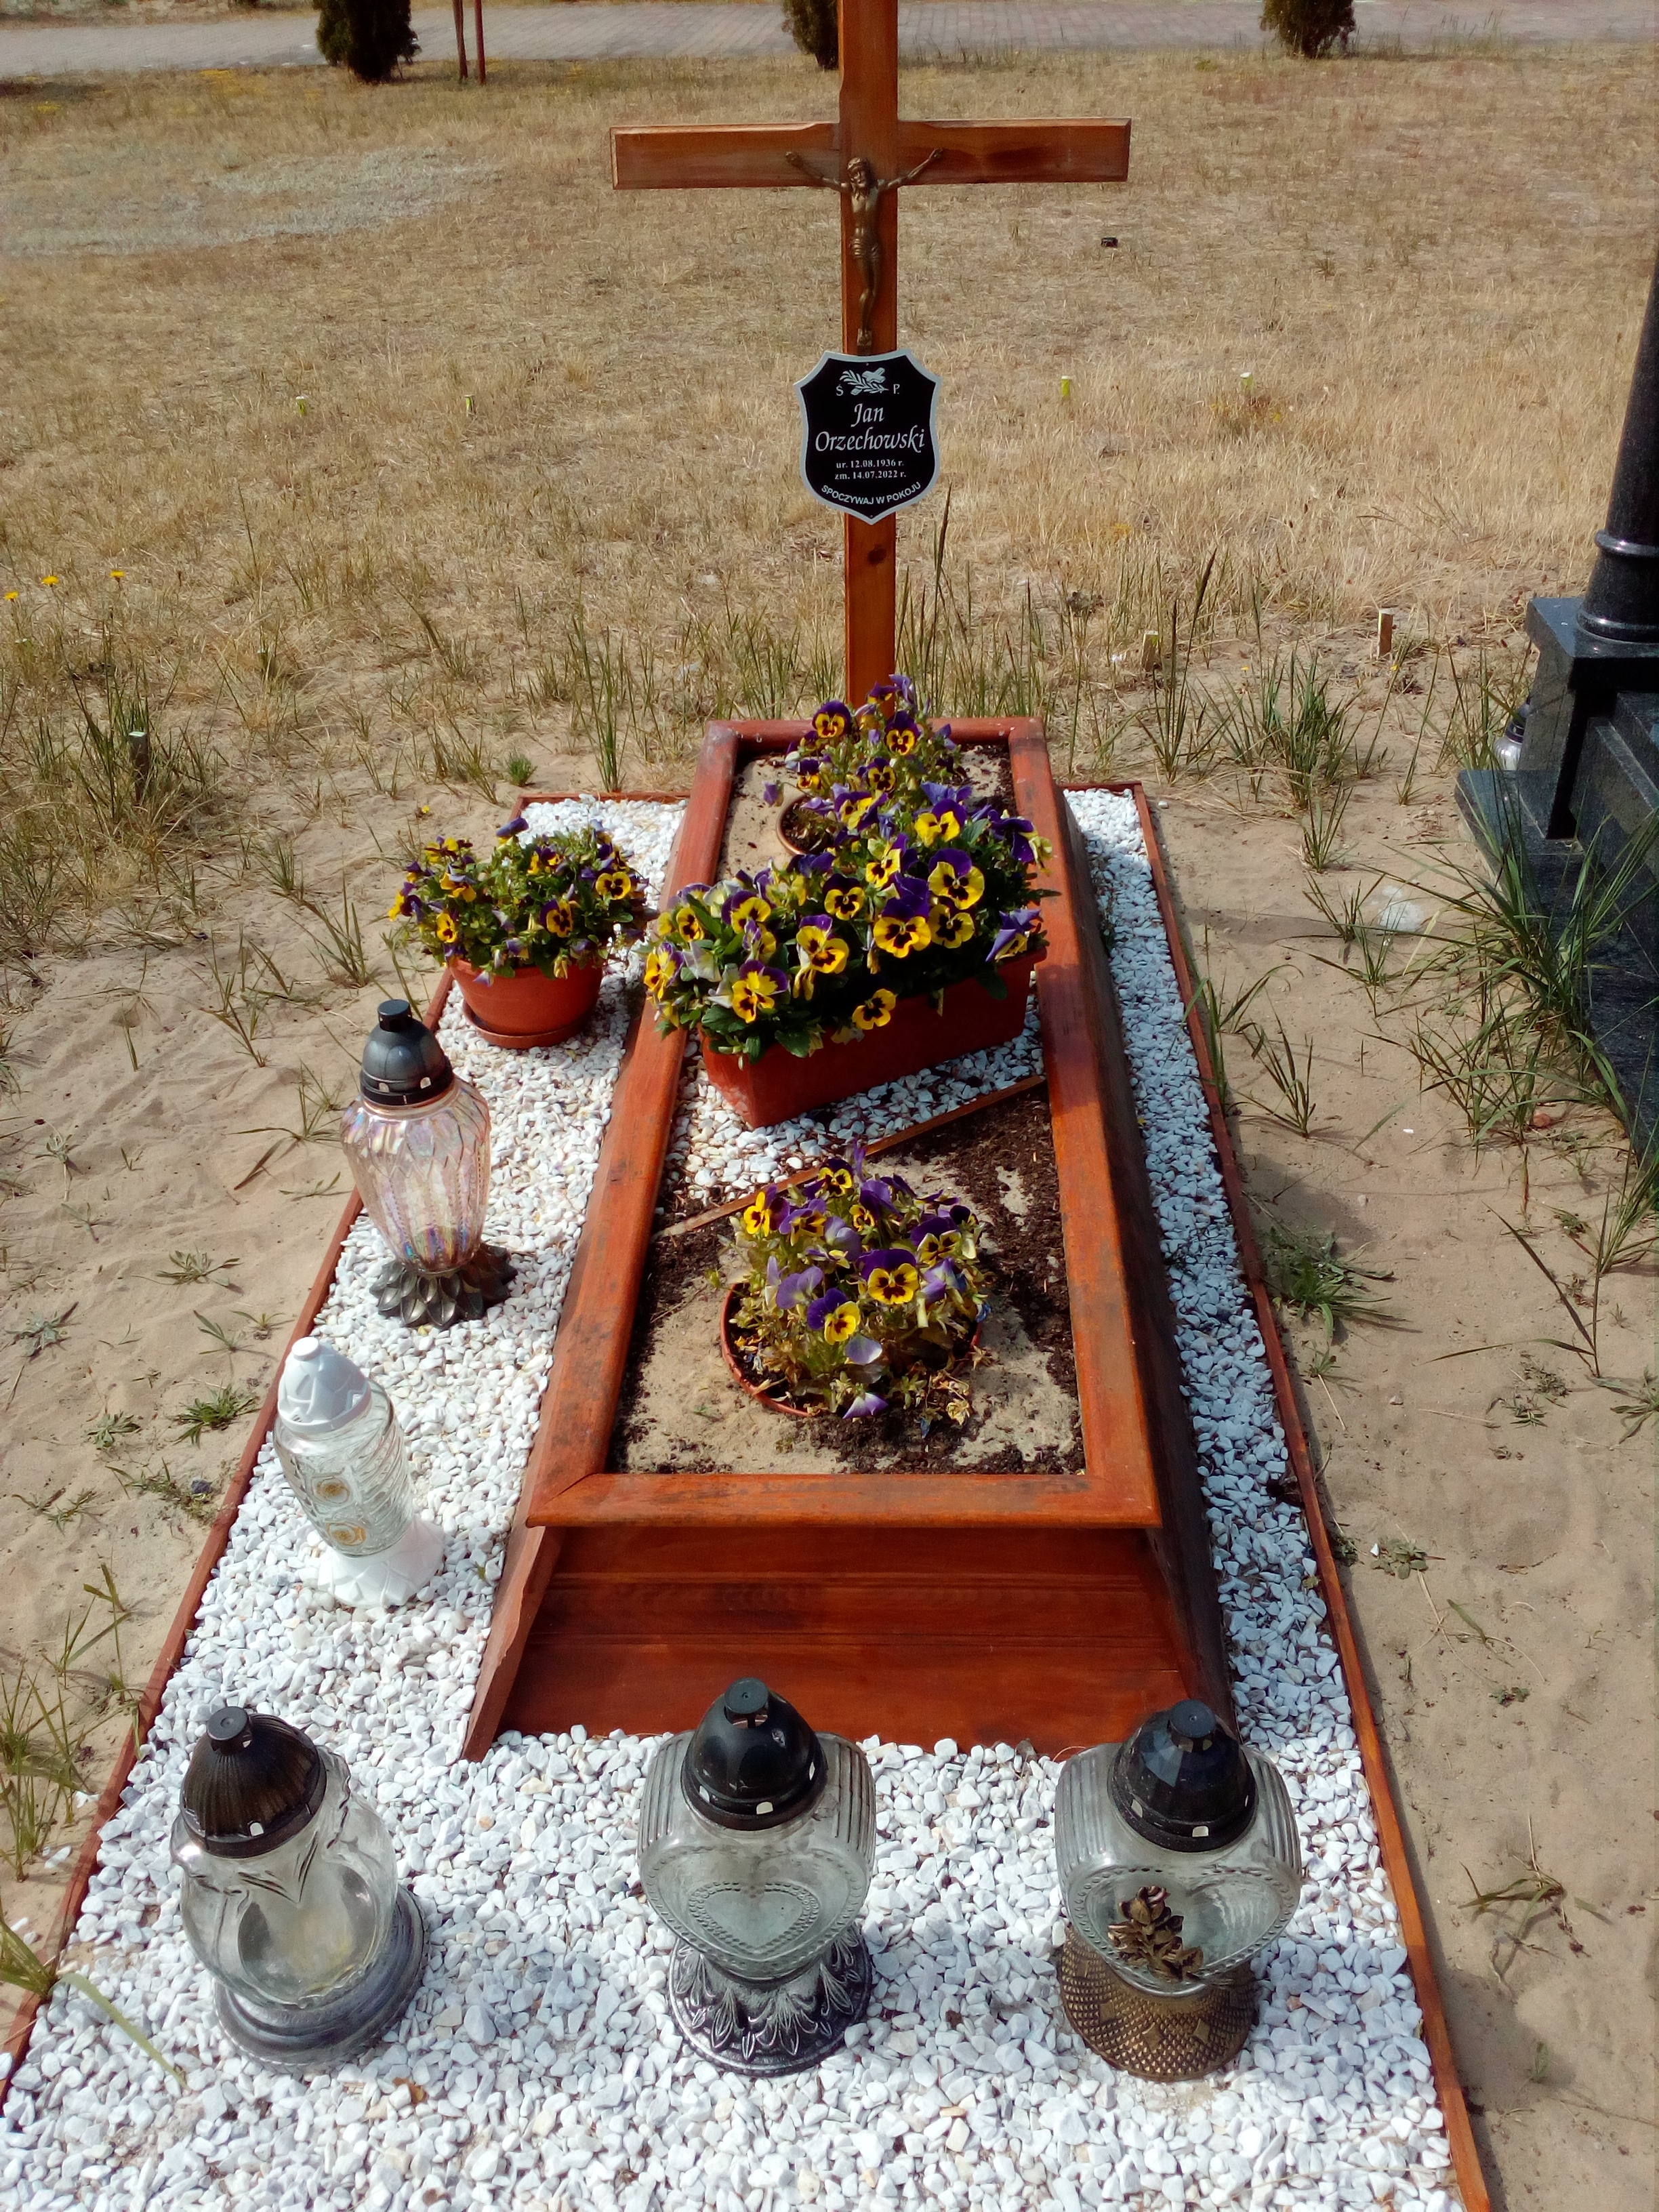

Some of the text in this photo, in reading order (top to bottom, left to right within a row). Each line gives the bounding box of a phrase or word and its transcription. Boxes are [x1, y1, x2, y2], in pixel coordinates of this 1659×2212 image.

[851, 403, 884, 427] Jan
[815, 425, 925, 453] Orzechowski
[851, 459, 896, 468] 12.08.1936
[853, 470, 898, 479] 14.07.2022
[821, 481, 922, 505] SPOCZYWAJ W POKOJU
